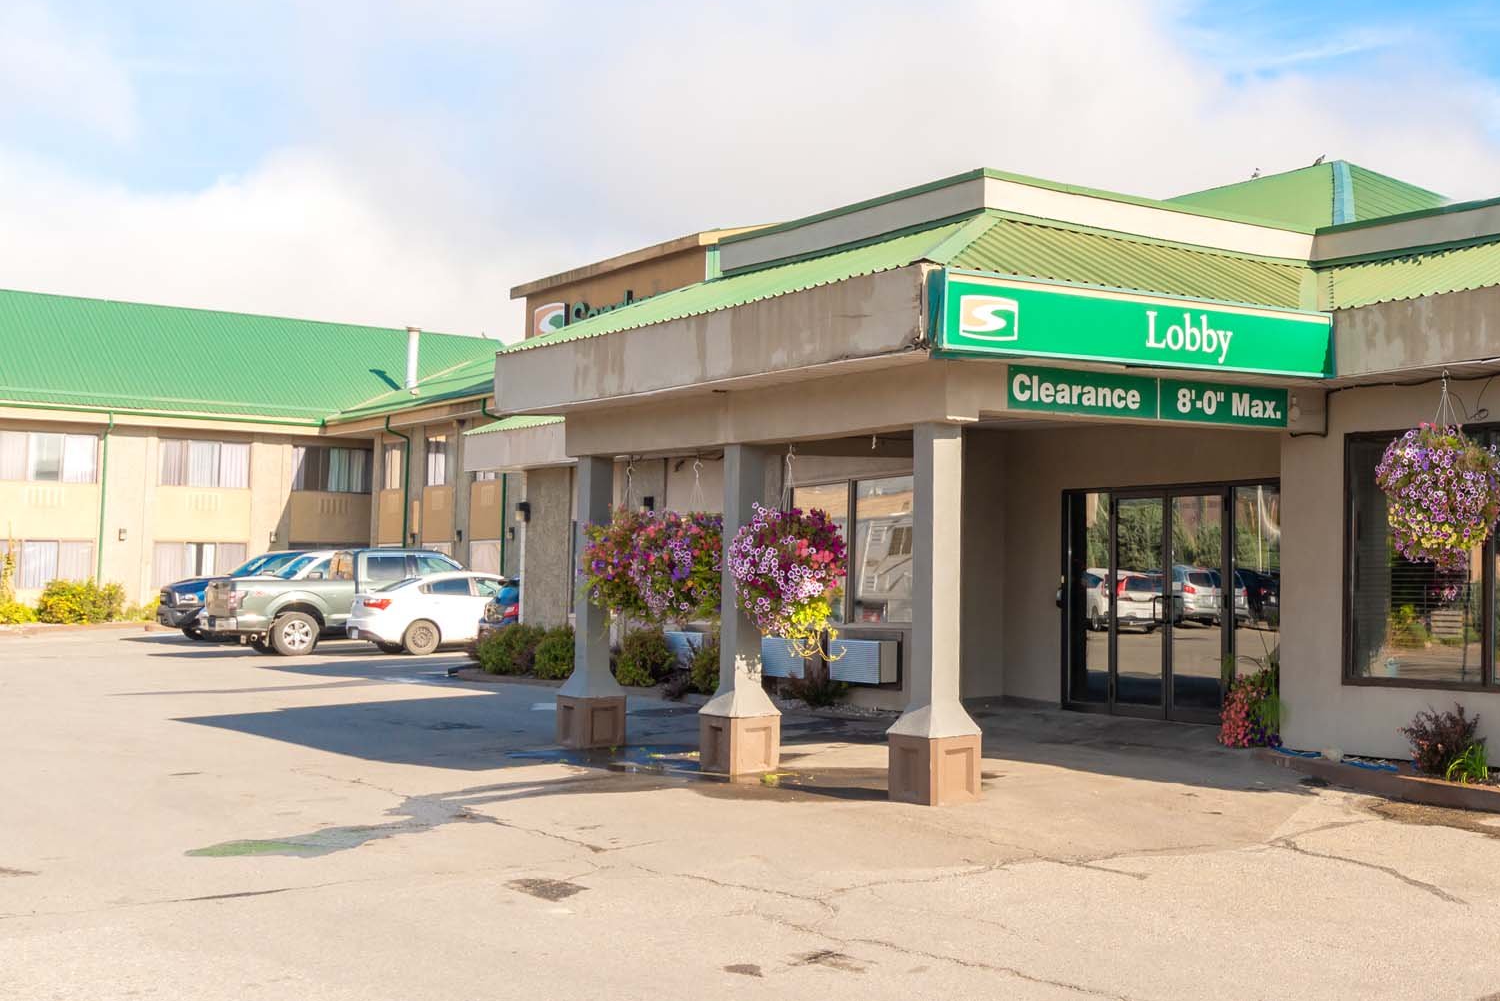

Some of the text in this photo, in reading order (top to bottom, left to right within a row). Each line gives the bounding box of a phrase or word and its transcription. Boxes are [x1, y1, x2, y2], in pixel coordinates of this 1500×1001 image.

[1145, 310, 1233, 364] Lobby
[1012, 373, 1141, 410] Clearance
[1177, 388, 1281, 419] 8'-0" Max.
